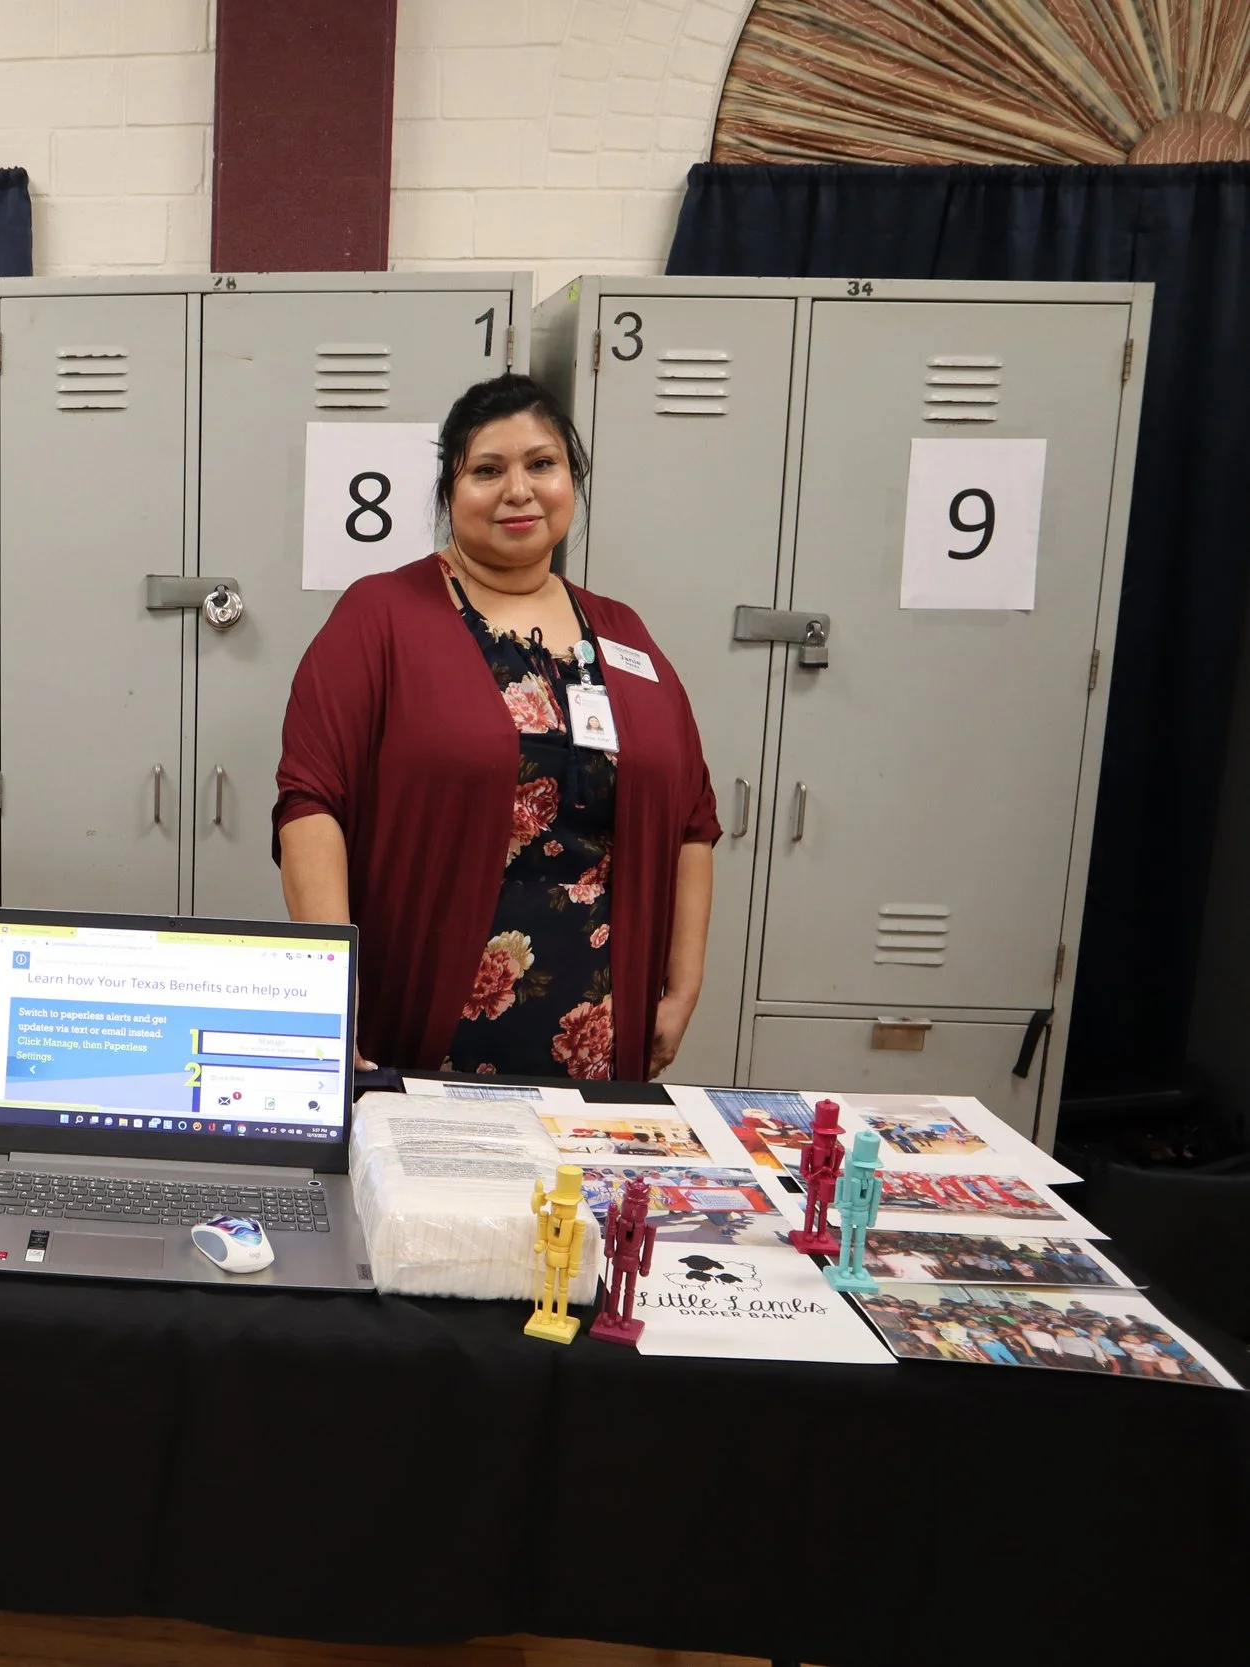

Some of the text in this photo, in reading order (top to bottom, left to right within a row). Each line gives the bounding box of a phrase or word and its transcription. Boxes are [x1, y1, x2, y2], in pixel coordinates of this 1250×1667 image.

[847, 281, 873, 296] 34
[475, 307, 494, 357] 1
[611, 311, 643, 361] 3
[345, 471, 392, 542] 8
[948, 488, 995, 560] 9
[27, 972, 307, 999] Learn how Your Texas Benefits can help you
[18, 1007, 167, 1026] Switch to paperless alerts and get
[18, 1022, 163, 1039] updates via text or email instead.
[189, 1028, 199, 1055] 1
[16, 1051, 54, 1063] Settings.
[17, 1037, 148, 1052] Click Manage, then Paperless
[184, 1061, 202, 1087] 2
[634, 1291, 829, 1315] Little Lambs
[679, 1309, 796, 1320] DIAPER BANK
